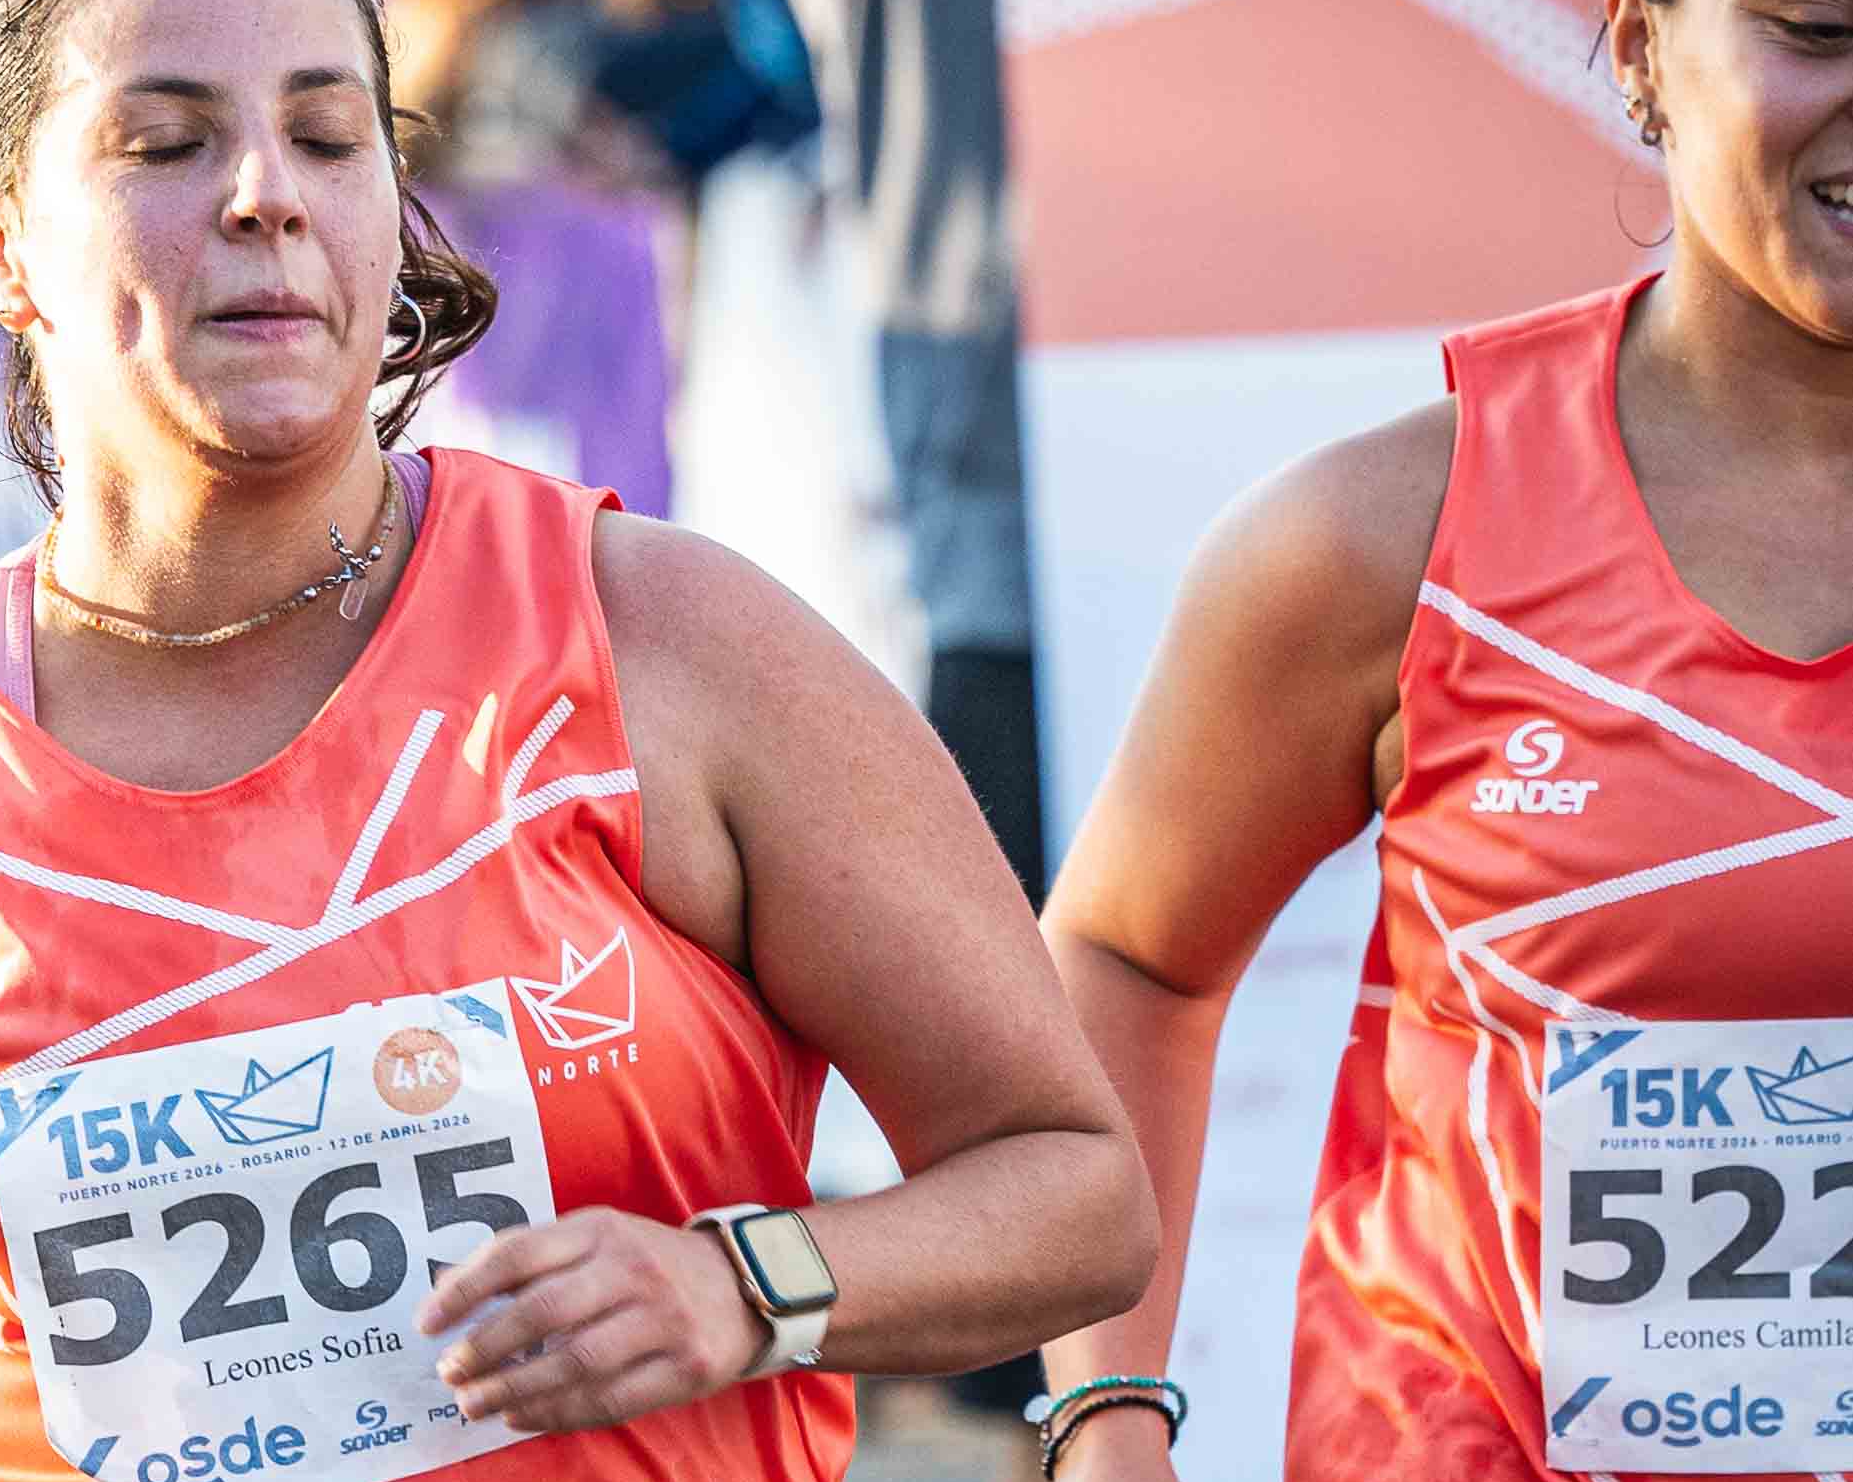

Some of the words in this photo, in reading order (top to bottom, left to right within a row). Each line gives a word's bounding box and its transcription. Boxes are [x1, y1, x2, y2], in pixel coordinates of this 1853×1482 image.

[391, 1046, 450, 1092] 4K
[538, 1043, 639, 1086] NORTE
[1601, 1067, 1735, 1127] 15K
[47, 1093, 195, 1181] 15K
[59, 1182, 121, 1203] PUERTO
[127, 1170, 180, 1193] NORTE
[185, 1164, 224, 1182] 2026
[242, 1146, 311, 1169] ROSARIO
[329, 1137, 348, 1151] 12
[353, 1130, 373, 1146] DE
[380, 1122, 426, 1142] ABRIL
[433, 1114, 471, 1131] 2026
[1600, 1138, 1660, 1150] PUERTO
[1665, 1136, 1717, 1150] NORTE
[1775, 1132, 1843, 1147] ROSARIO
[33, 1136, 531, 1368] 5265
[1644, 1323, 1747, 1350] Leones
[203, 1349, 314, 1388] Leones
[1622, 1384, 1785, 1448] osde
